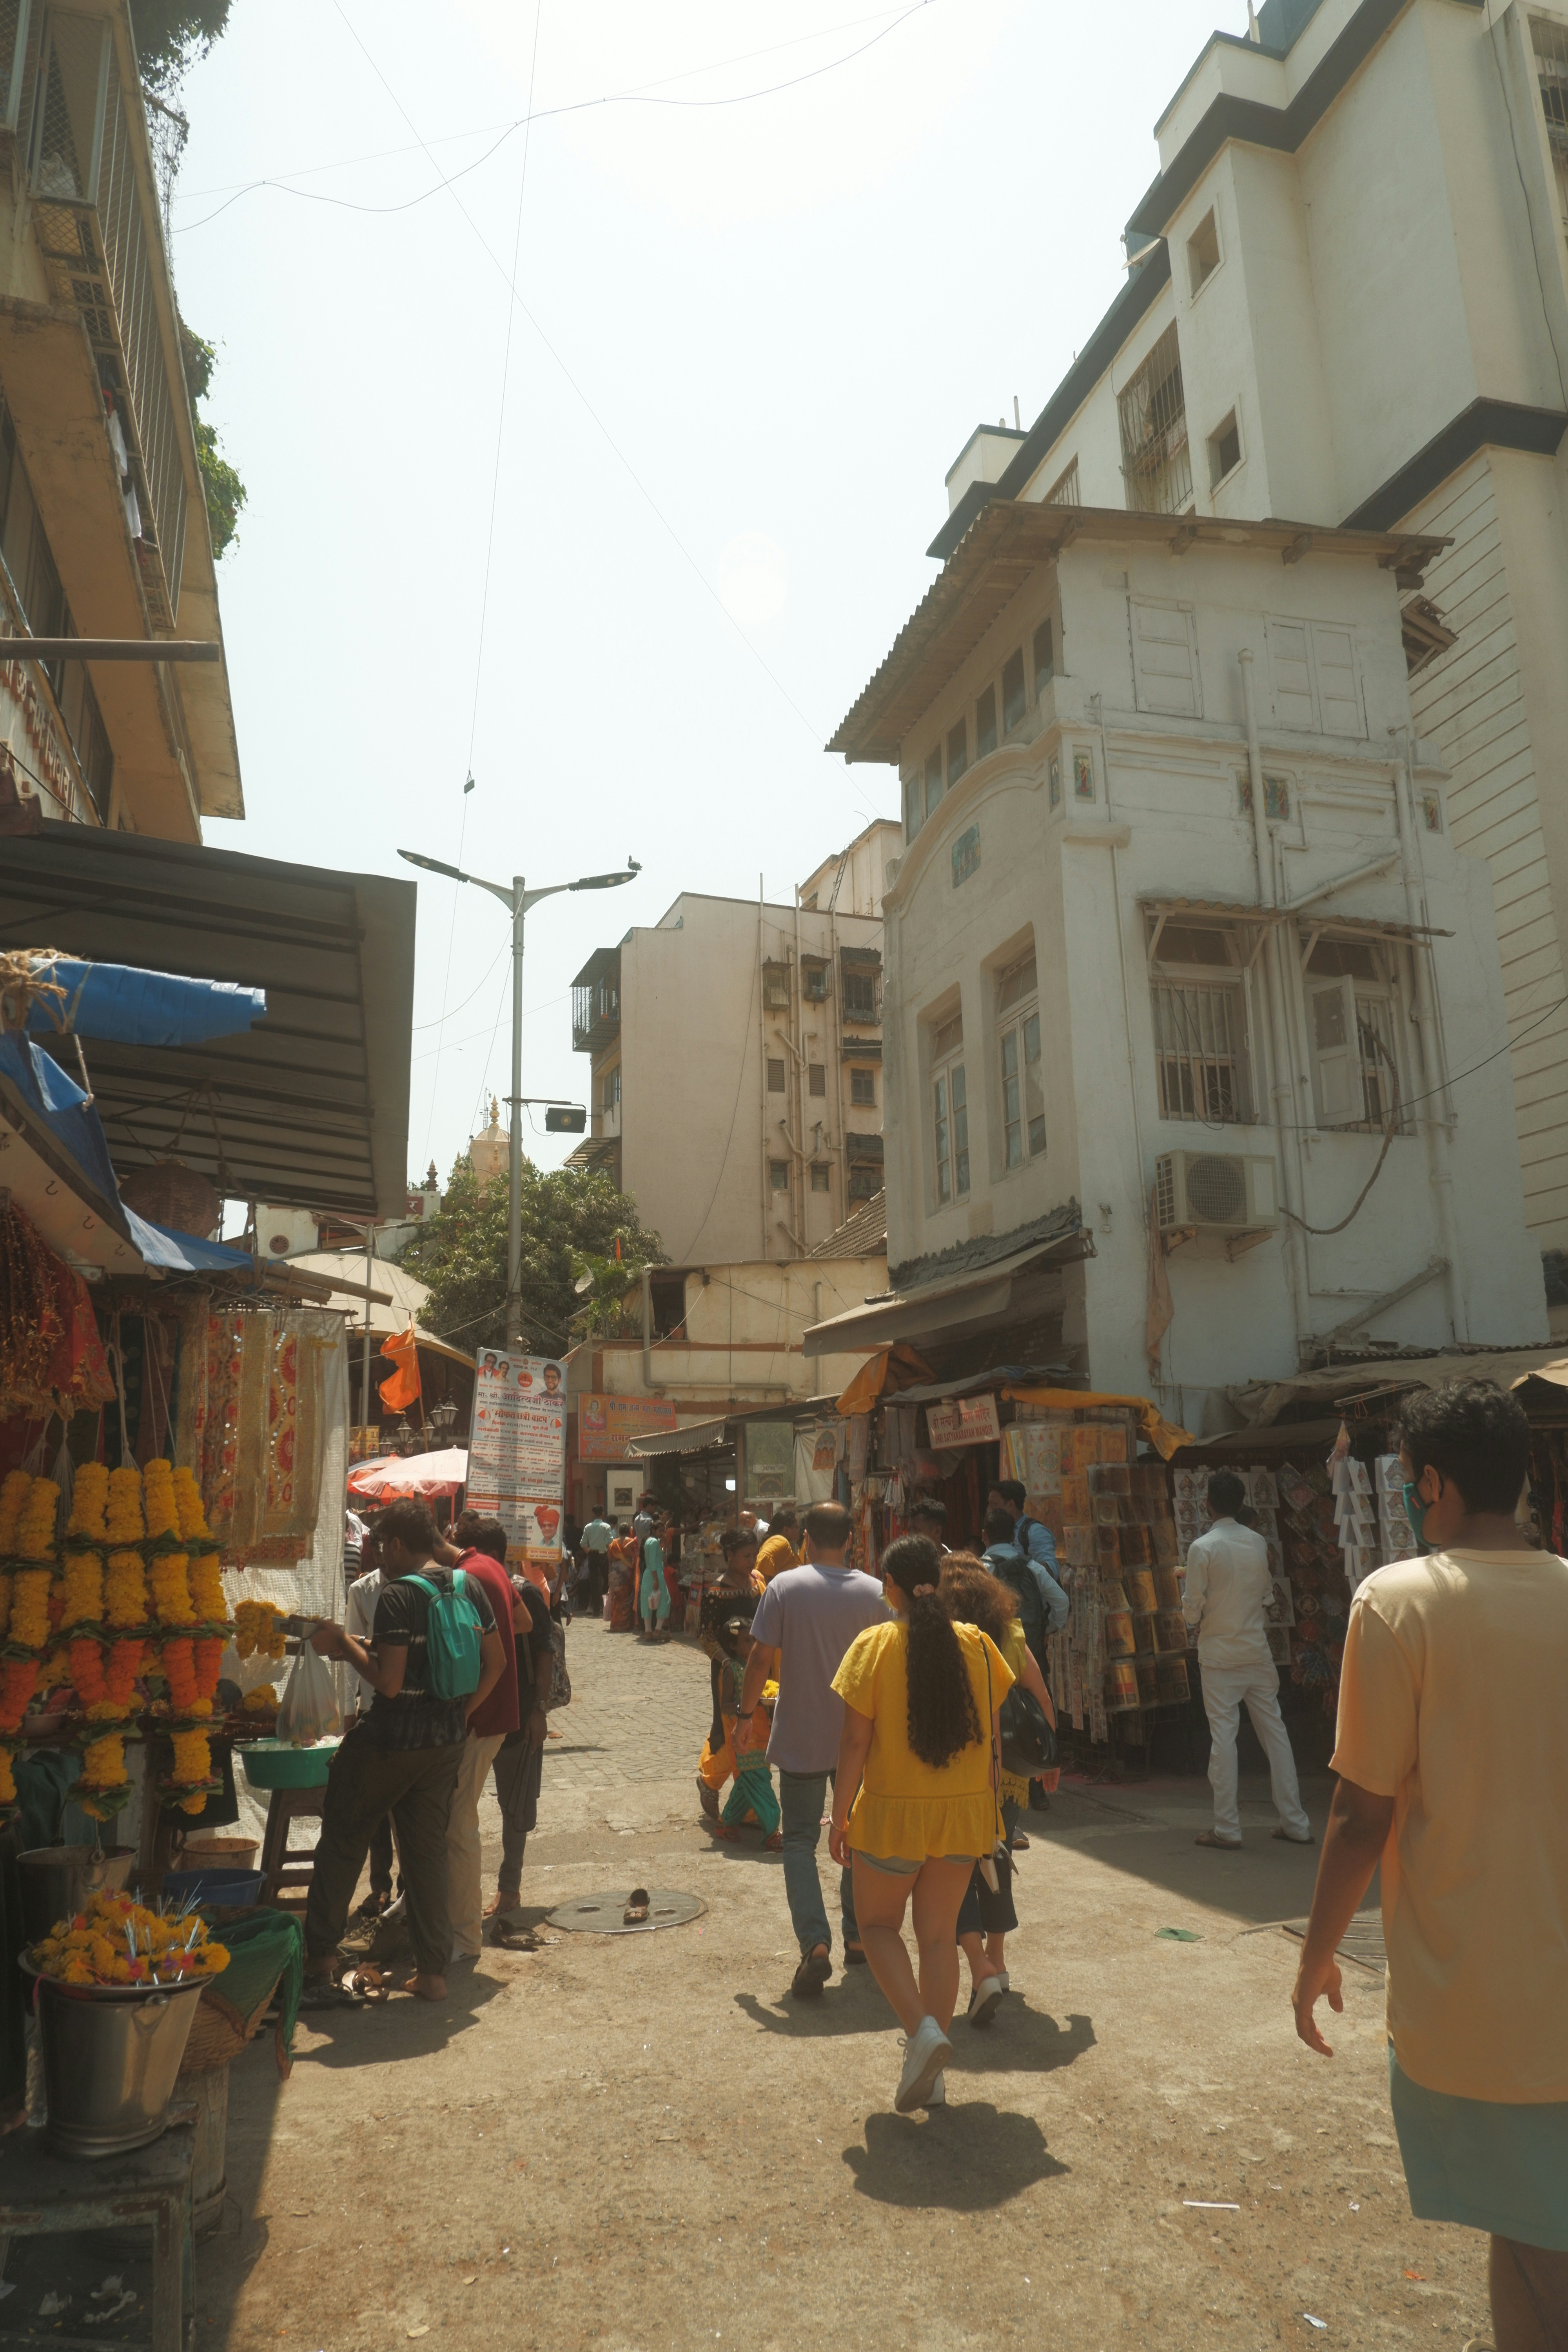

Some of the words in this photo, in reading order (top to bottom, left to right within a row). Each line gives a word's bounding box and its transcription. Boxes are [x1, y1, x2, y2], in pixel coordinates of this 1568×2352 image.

[503, 1392, 541, 1405] आदित्यजी
[543, 1397, 564, 1407] ठाकरे
[517, 1412, 530, 1421] छत्री
[618, 1403, 627, 1411] राम
[628, 1404, 640, 1412] जन्म
[653, 1405, 672, 1415] महोत्सव
[974, 1403, 991, 1422] मंदिर
[935, 1434, 944, 1444] SHRI
[944, 1428, 975, 1443] SATYANARAYAN
[975, 1424, 994, 1437] MANDIR
